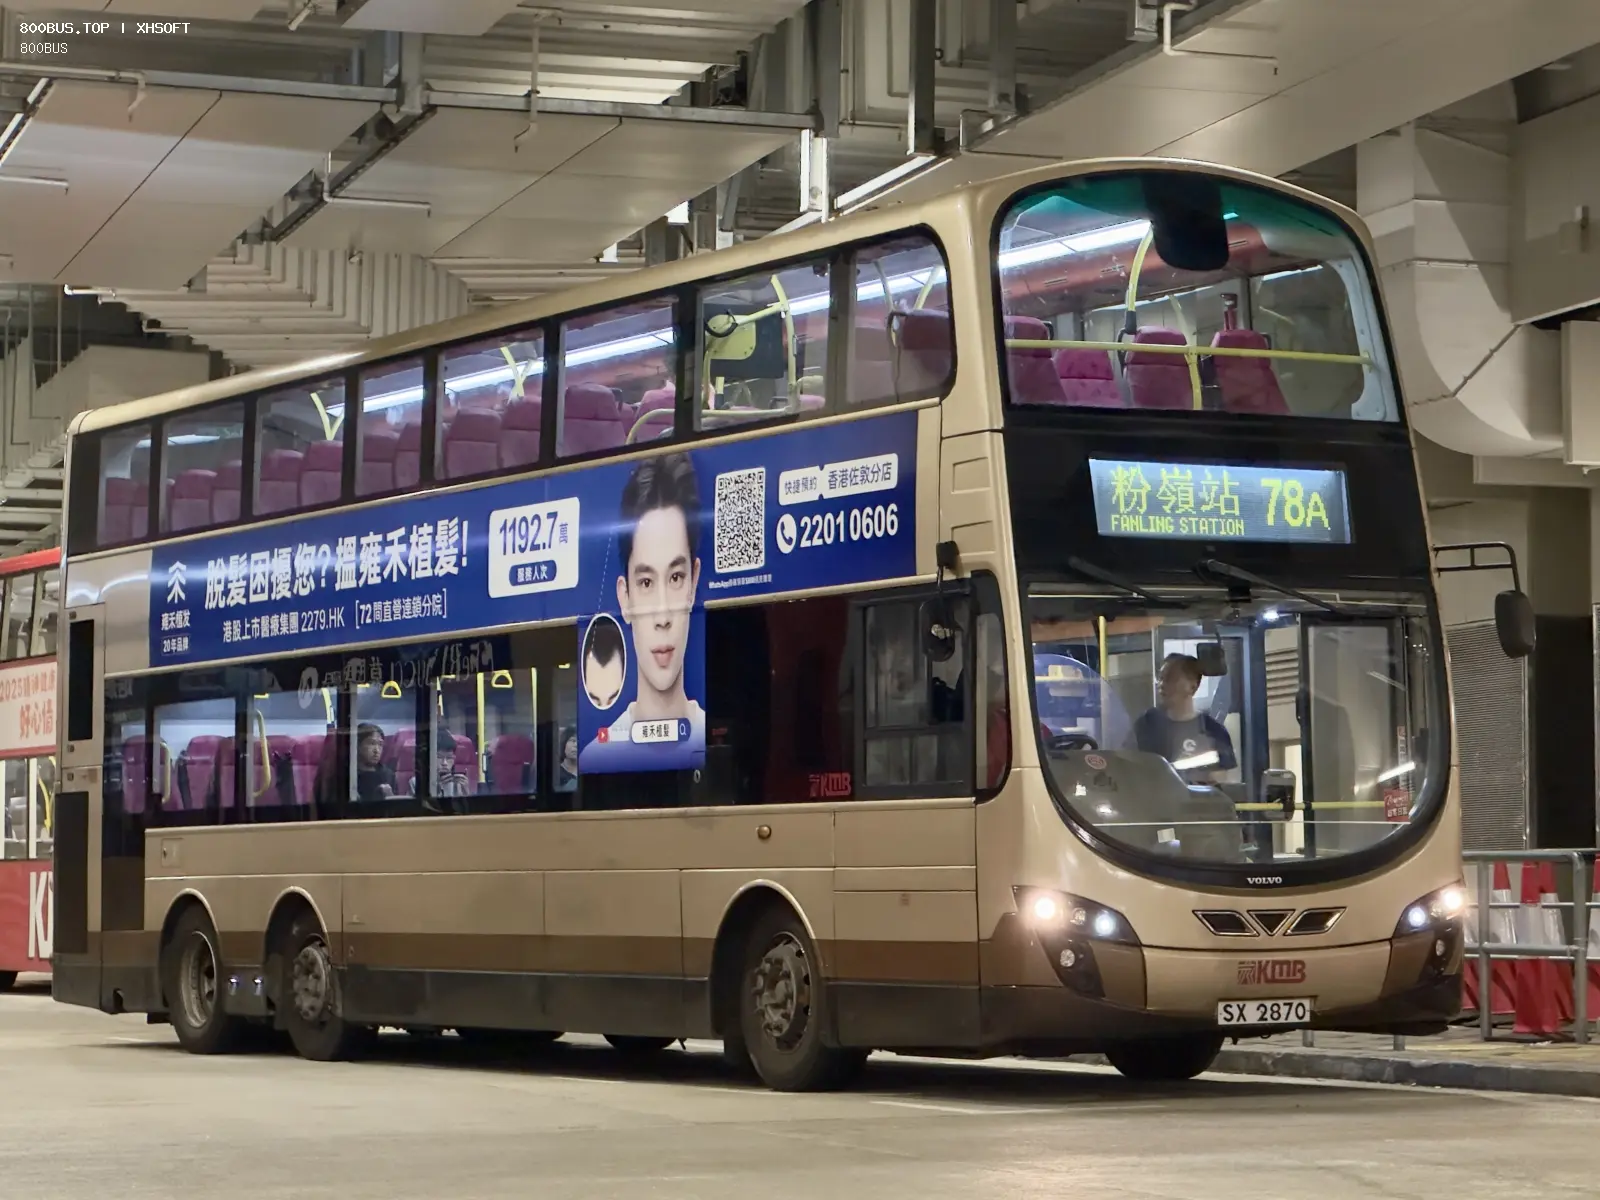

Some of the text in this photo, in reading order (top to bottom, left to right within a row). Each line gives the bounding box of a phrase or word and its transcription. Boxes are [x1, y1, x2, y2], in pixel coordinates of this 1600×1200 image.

[784, 461, 892, 496] 快捷預約 香港佐敦分店
[1110, 464, 1240, 517] 粉嶺站
[1261, 477, 1331, 529] 78A
[800, 503, 898, 548] 2201 0606
[1111, 514, 1245, 536] FANLING STATION
[517, 564, 548, 583] 服務人次
[301, 606, 345, 633] 2279.HK
[820, 772, 852, 797] KMB
[1246, 876, 1283, 885] VOLVO
[1257, 959, 1307, 985] KMB
[1222, 1002, 1307, 1023] SX 2870
